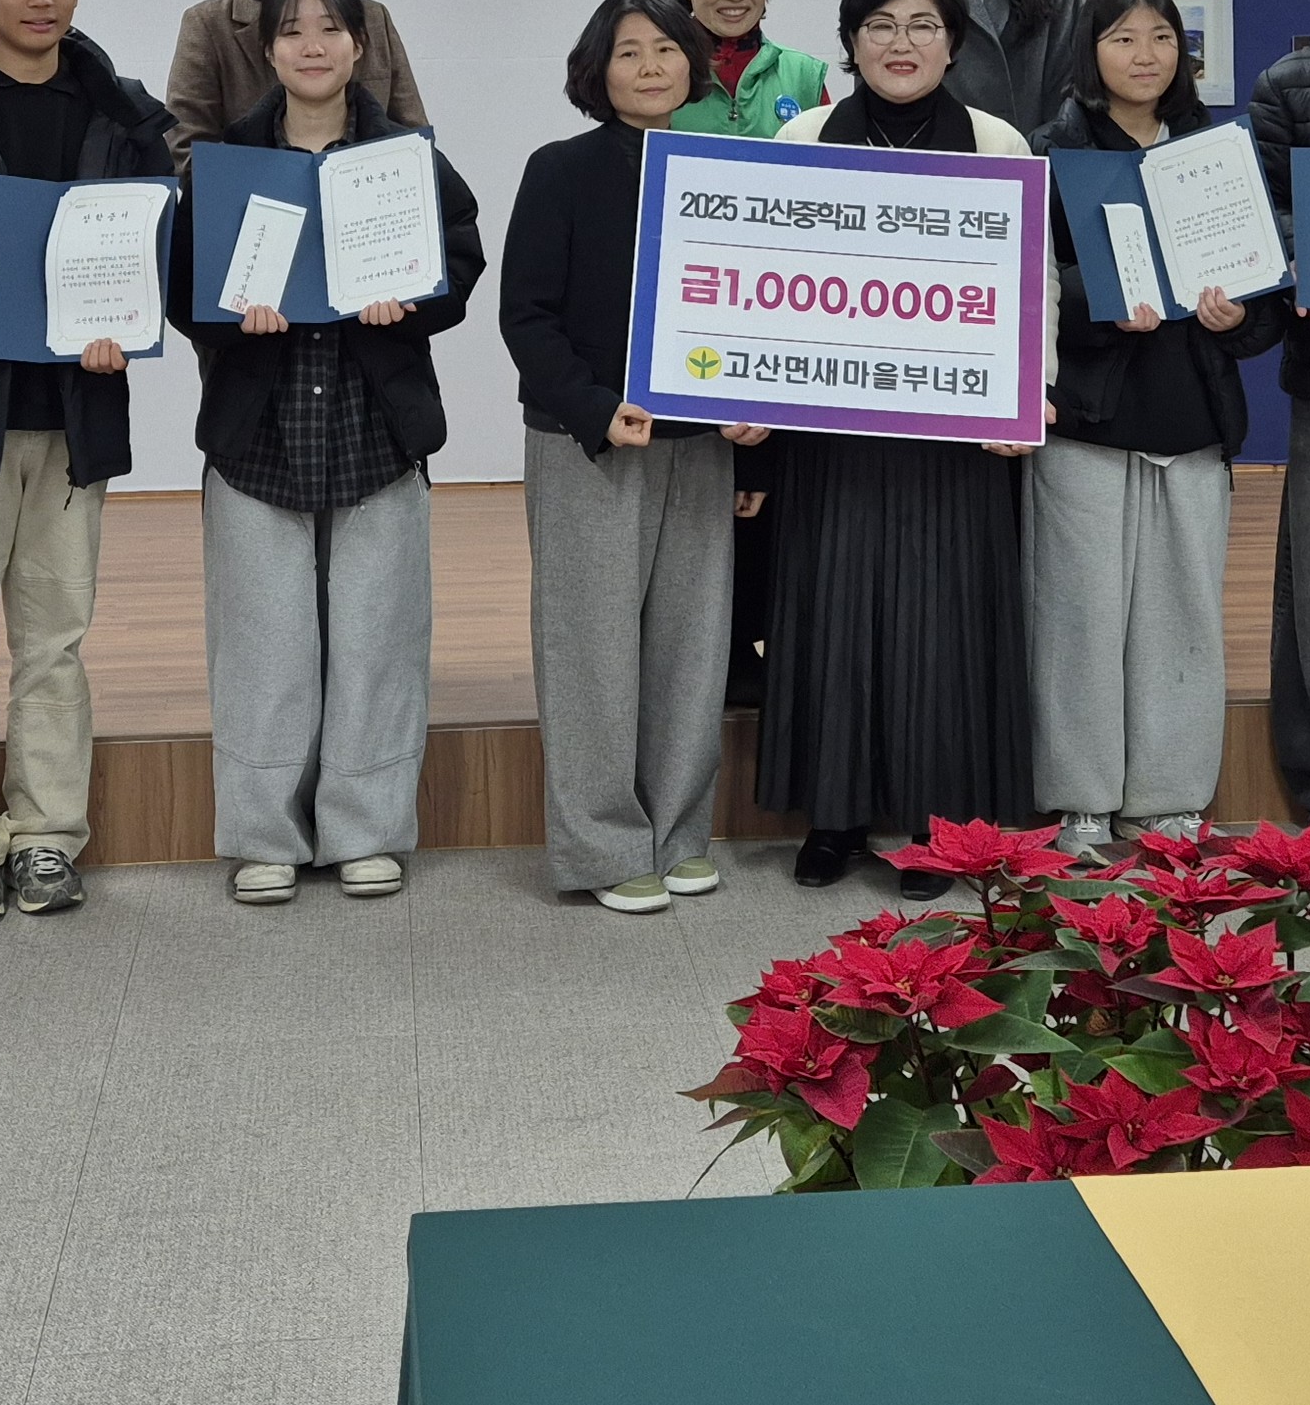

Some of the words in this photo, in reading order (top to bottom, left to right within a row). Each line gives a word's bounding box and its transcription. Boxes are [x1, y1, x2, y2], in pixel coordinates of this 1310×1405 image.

[679, 191, 738, 222] 2025
[742, 195, 867, 232] 고산중학교
[875, 203, 951, 237] 장학금
[958, 209, 1011, 240] 전달
[680, 263, 997, 326] 금1,000,000원
[723, 350, 989, 398] 고산면새마을부녀회
